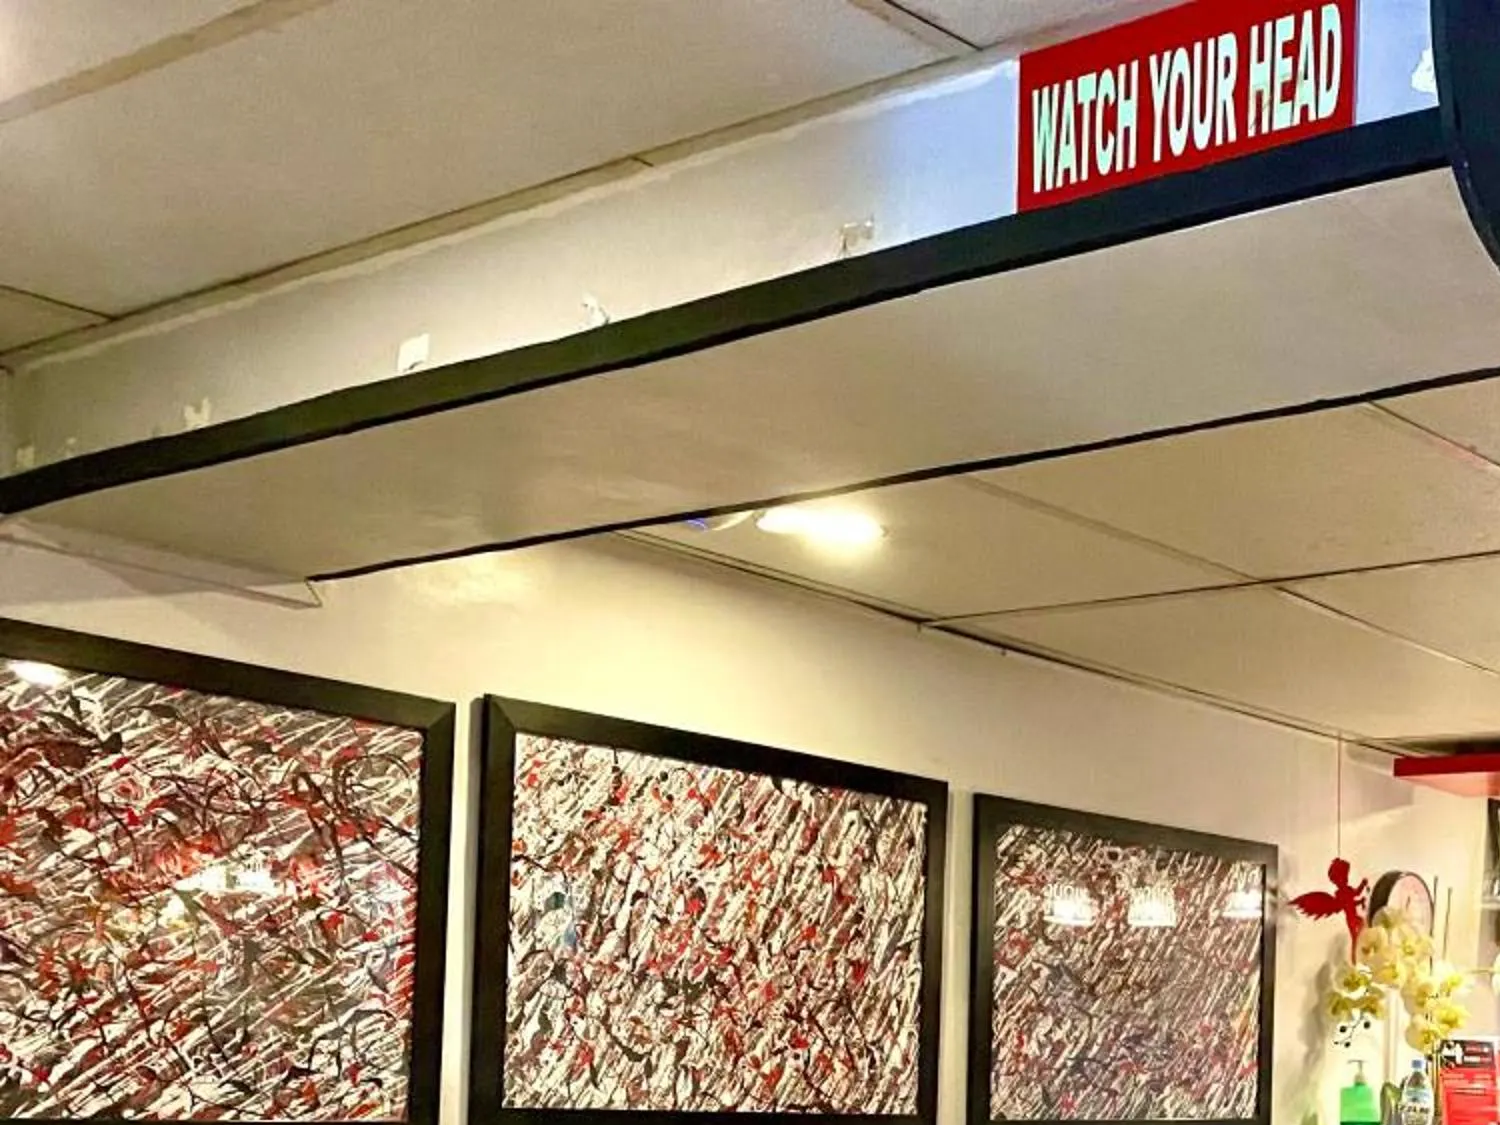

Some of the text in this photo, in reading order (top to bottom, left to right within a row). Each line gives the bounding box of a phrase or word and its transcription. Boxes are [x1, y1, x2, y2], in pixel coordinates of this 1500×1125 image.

[1032, 3, 1343, 194] WATCH YOUR HEAD
